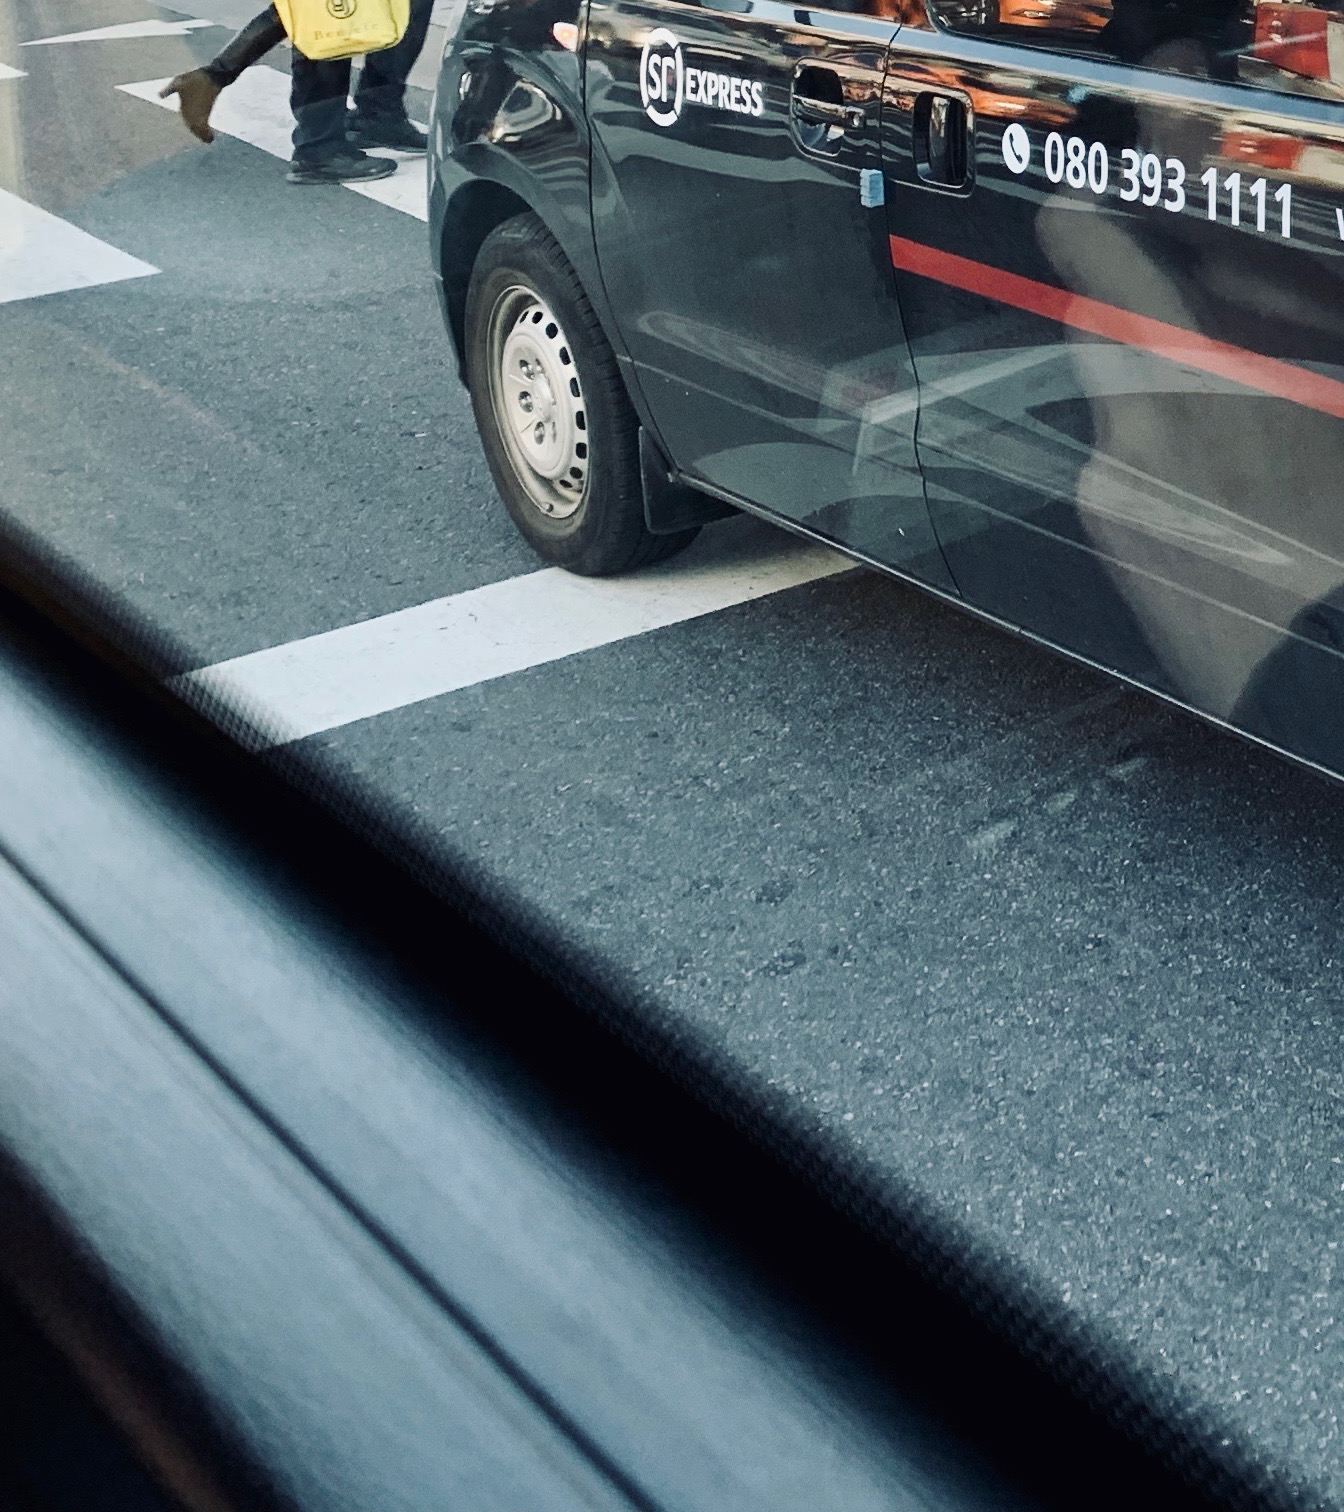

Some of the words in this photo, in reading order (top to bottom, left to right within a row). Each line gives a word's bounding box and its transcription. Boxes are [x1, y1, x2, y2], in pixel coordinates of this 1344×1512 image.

[685, 66, 764, 117] EXPRESS
[1043, 130, 1109, 195] 080
[1120, 147, 1186, 213] 393
[1199, 165, 1293, 239] 1111
